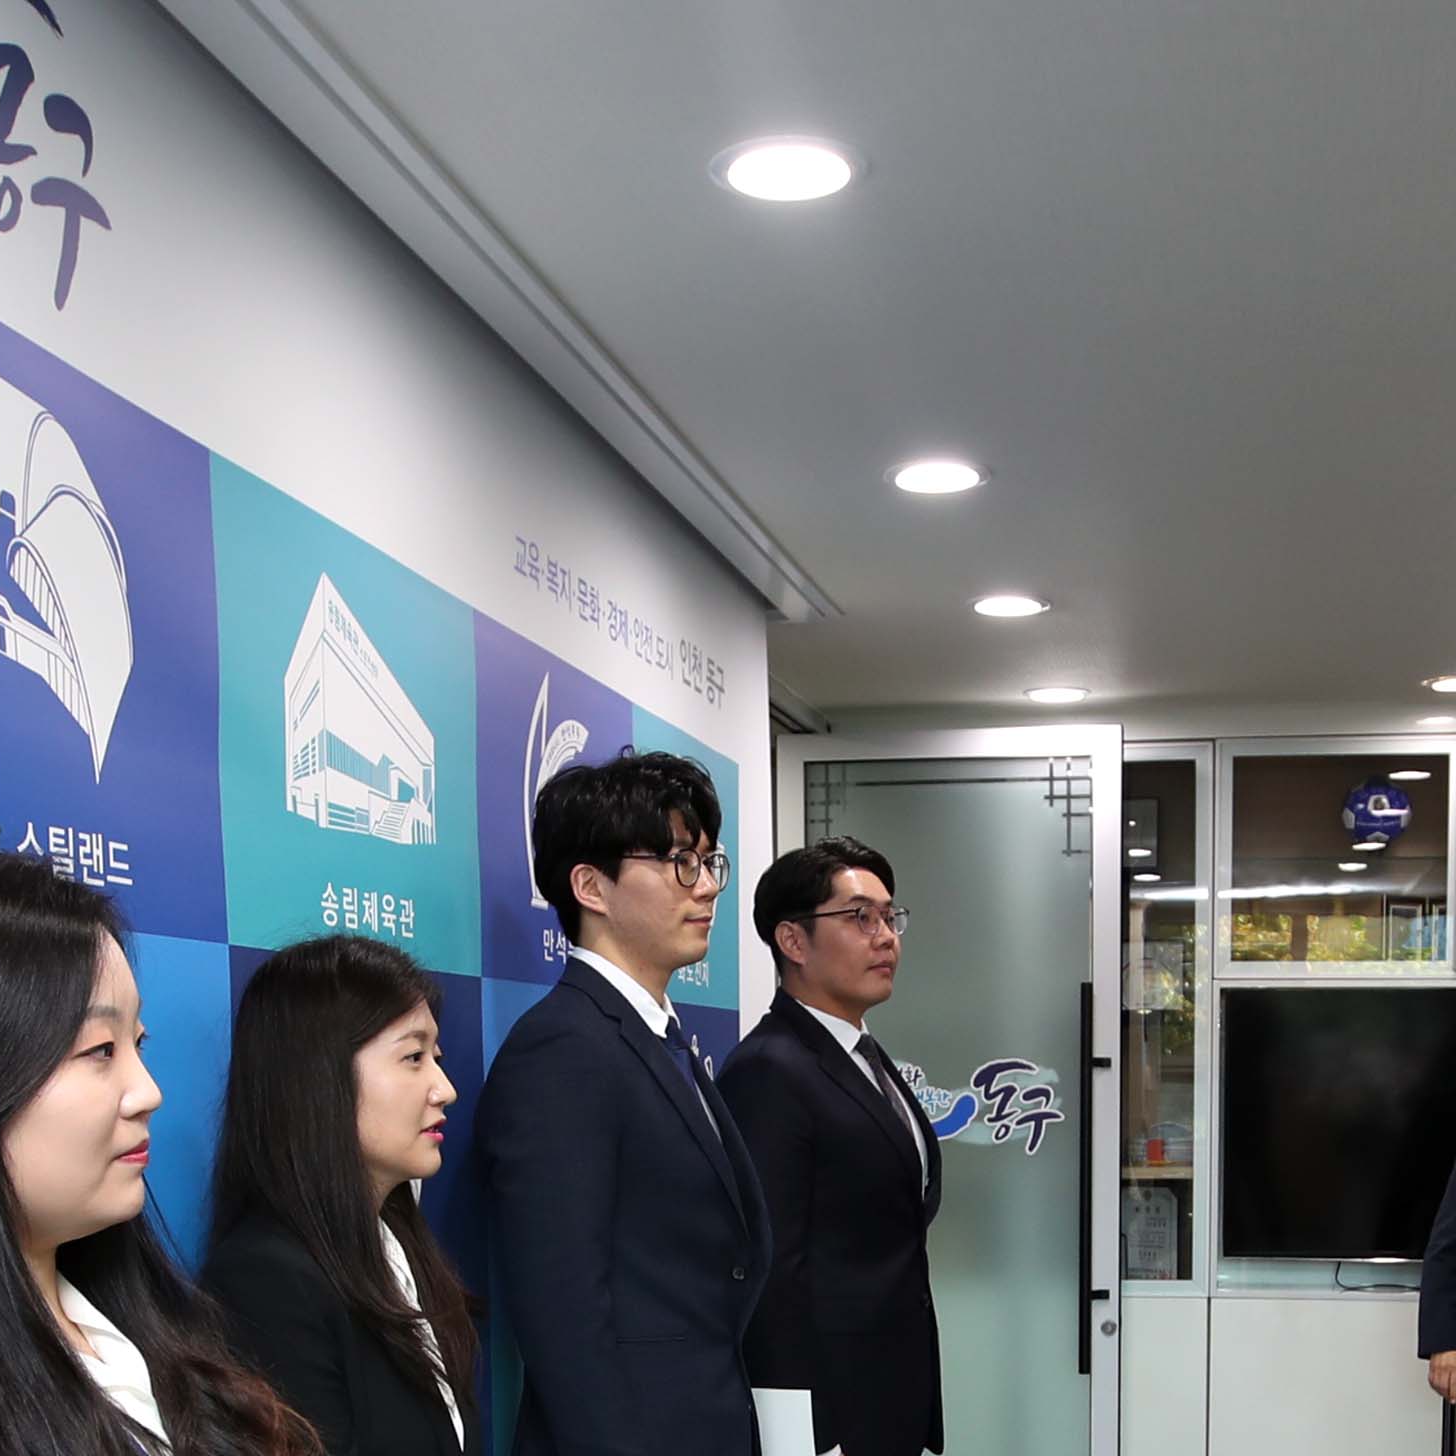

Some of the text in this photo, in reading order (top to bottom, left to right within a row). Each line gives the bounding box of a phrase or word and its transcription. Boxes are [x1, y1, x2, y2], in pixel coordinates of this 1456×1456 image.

[680, 637, 703, 693] 인천
[706, 657, 725, 709] 동구
[320, 881, 415, 938] 송림체육관
[973, 1060, 1063, 1153] 동구
